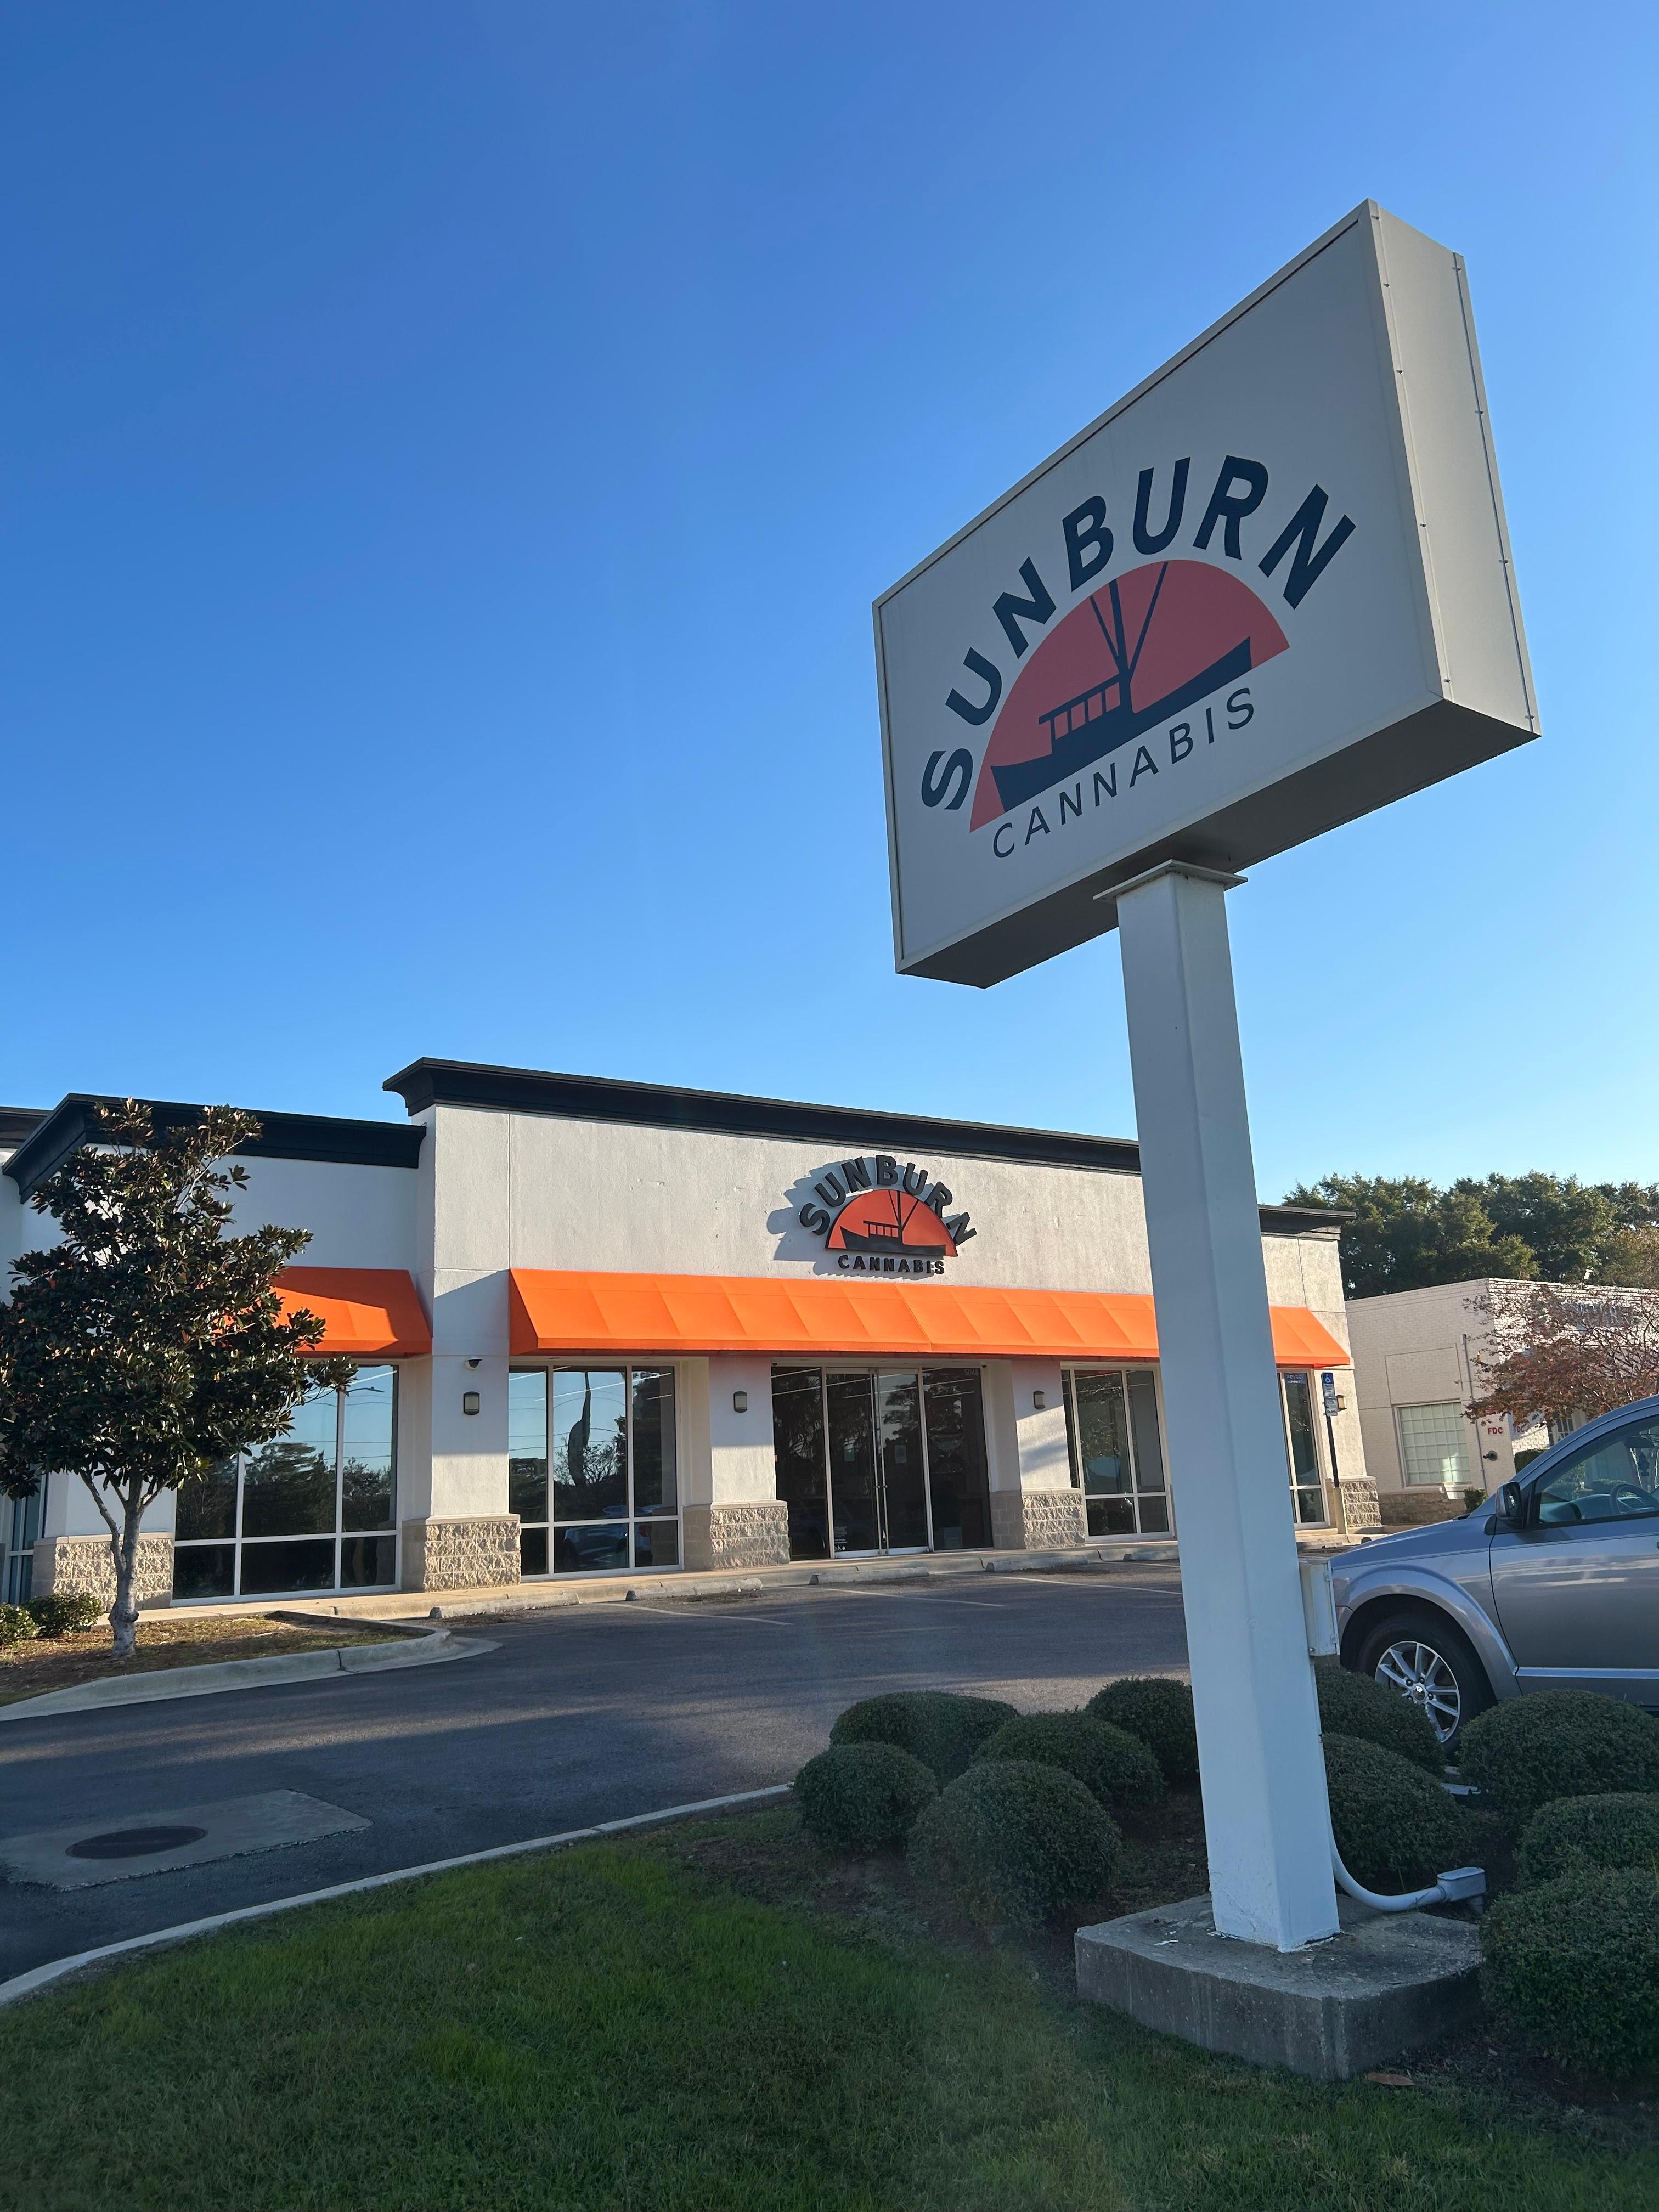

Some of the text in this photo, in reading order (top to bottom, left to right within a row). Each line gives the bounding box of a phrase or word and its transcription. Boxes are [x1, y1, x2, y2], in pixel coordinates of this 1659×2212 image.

[921, 455, 1356, 810] SUNBURN
[992, 687, 1254, 858] CANNABIS
[799, 1154, 978, 1246] SUNBURN
[838, 1255, 945, 1275] CANNABIS
